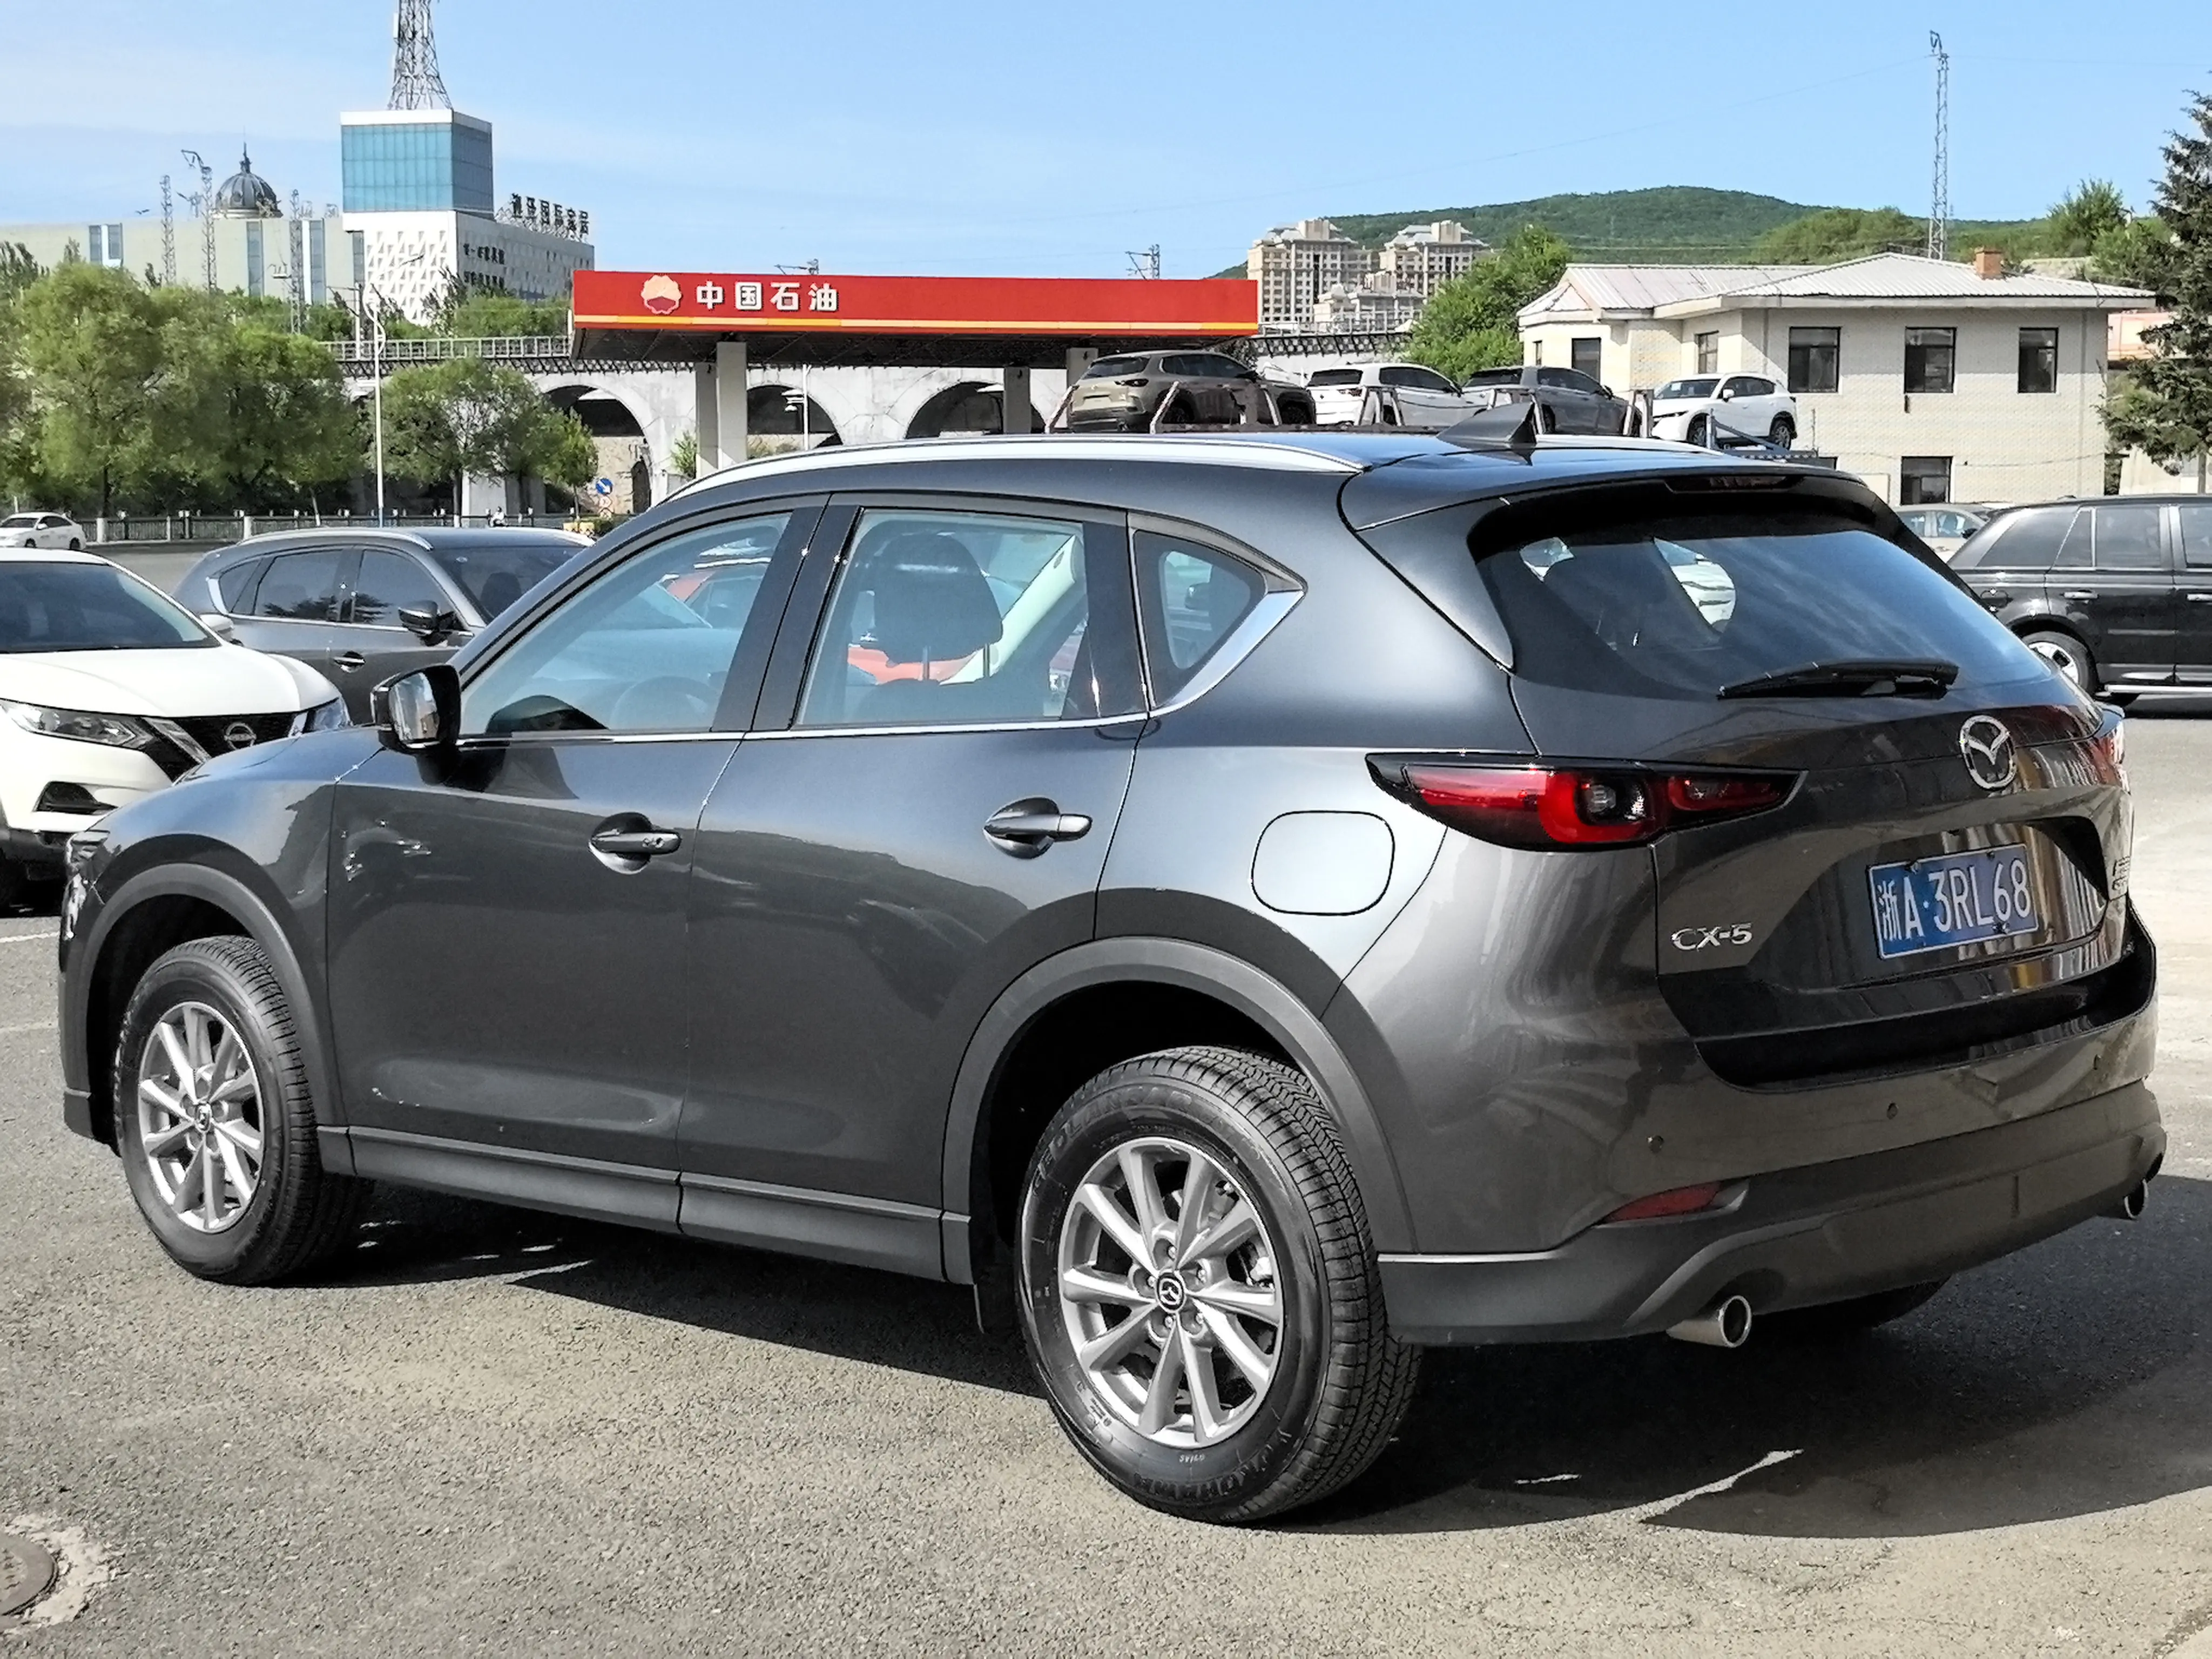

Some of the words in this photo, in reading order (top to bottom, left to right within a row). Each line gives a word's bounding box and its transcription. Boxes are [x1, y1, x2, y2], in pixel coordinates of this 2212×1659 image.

[697, 281, 838, 311] 中国石油
[1671, 923, 1752, 952] CX-5
